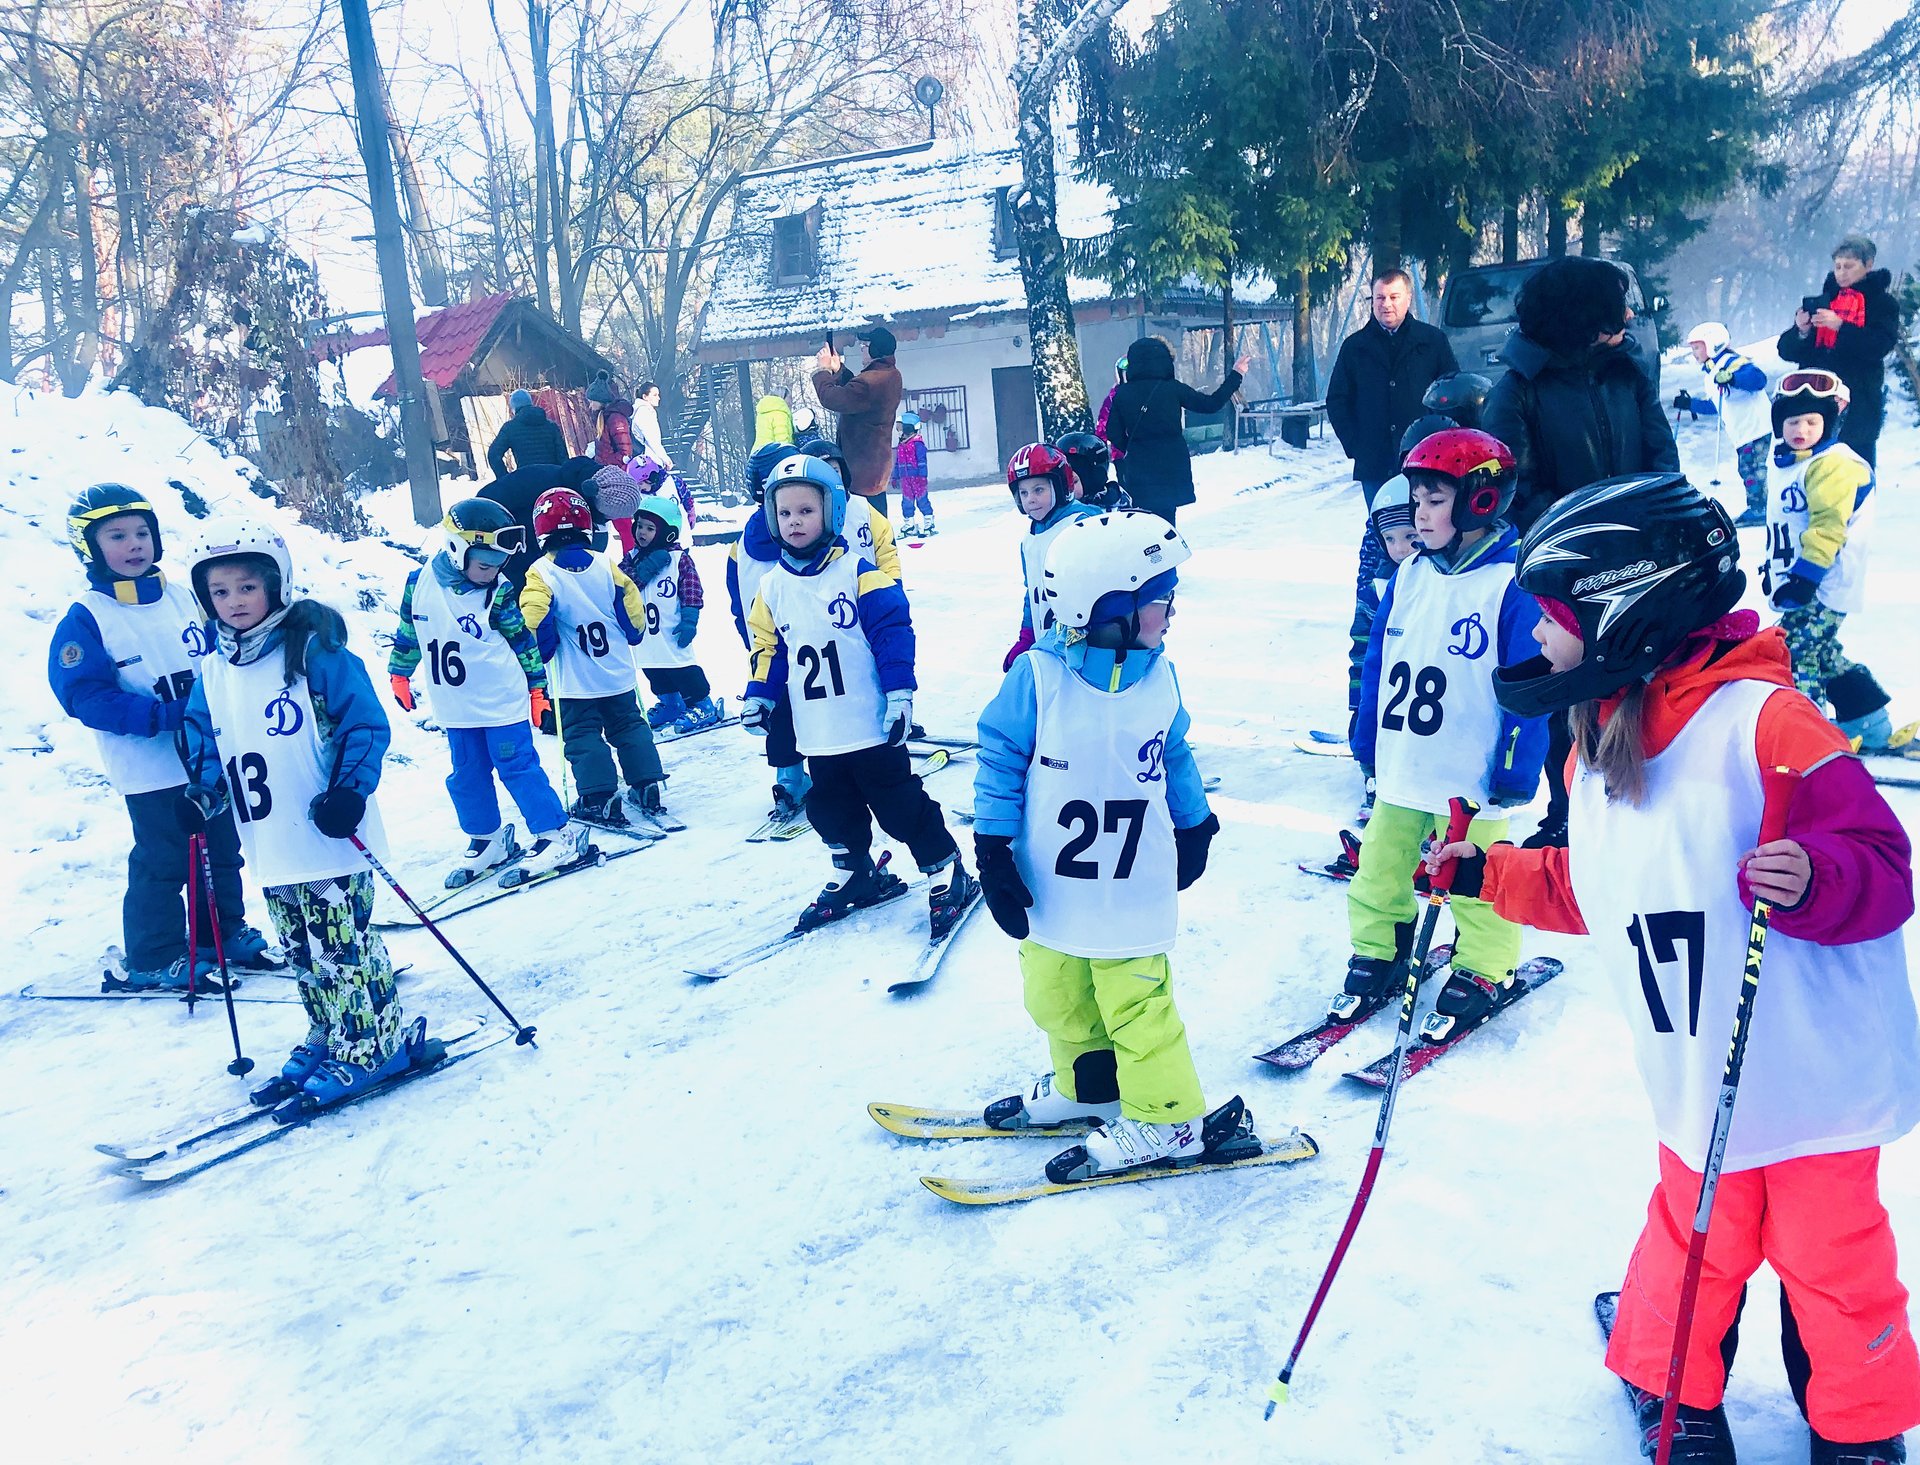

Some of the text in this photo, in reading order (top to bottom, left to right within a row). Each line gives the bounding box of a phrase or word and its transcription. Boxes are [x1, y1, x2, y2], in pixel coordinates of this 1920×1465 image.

[1766, 522, 1795, 568] 4
[576, 621, 609, 657] 19
[643, 602, 660, 635] 9
[427, 638, 466, 687] 16
[797, 640, 845, 701] 21
[1382, 661, 1447, 736] 28
[226, 752, 272, 824] 13
[1055, 799, 1150, 880] 27
[1626, 910, 1706, 1037] 17
[1744, 899, 1769, 987] LEKI
